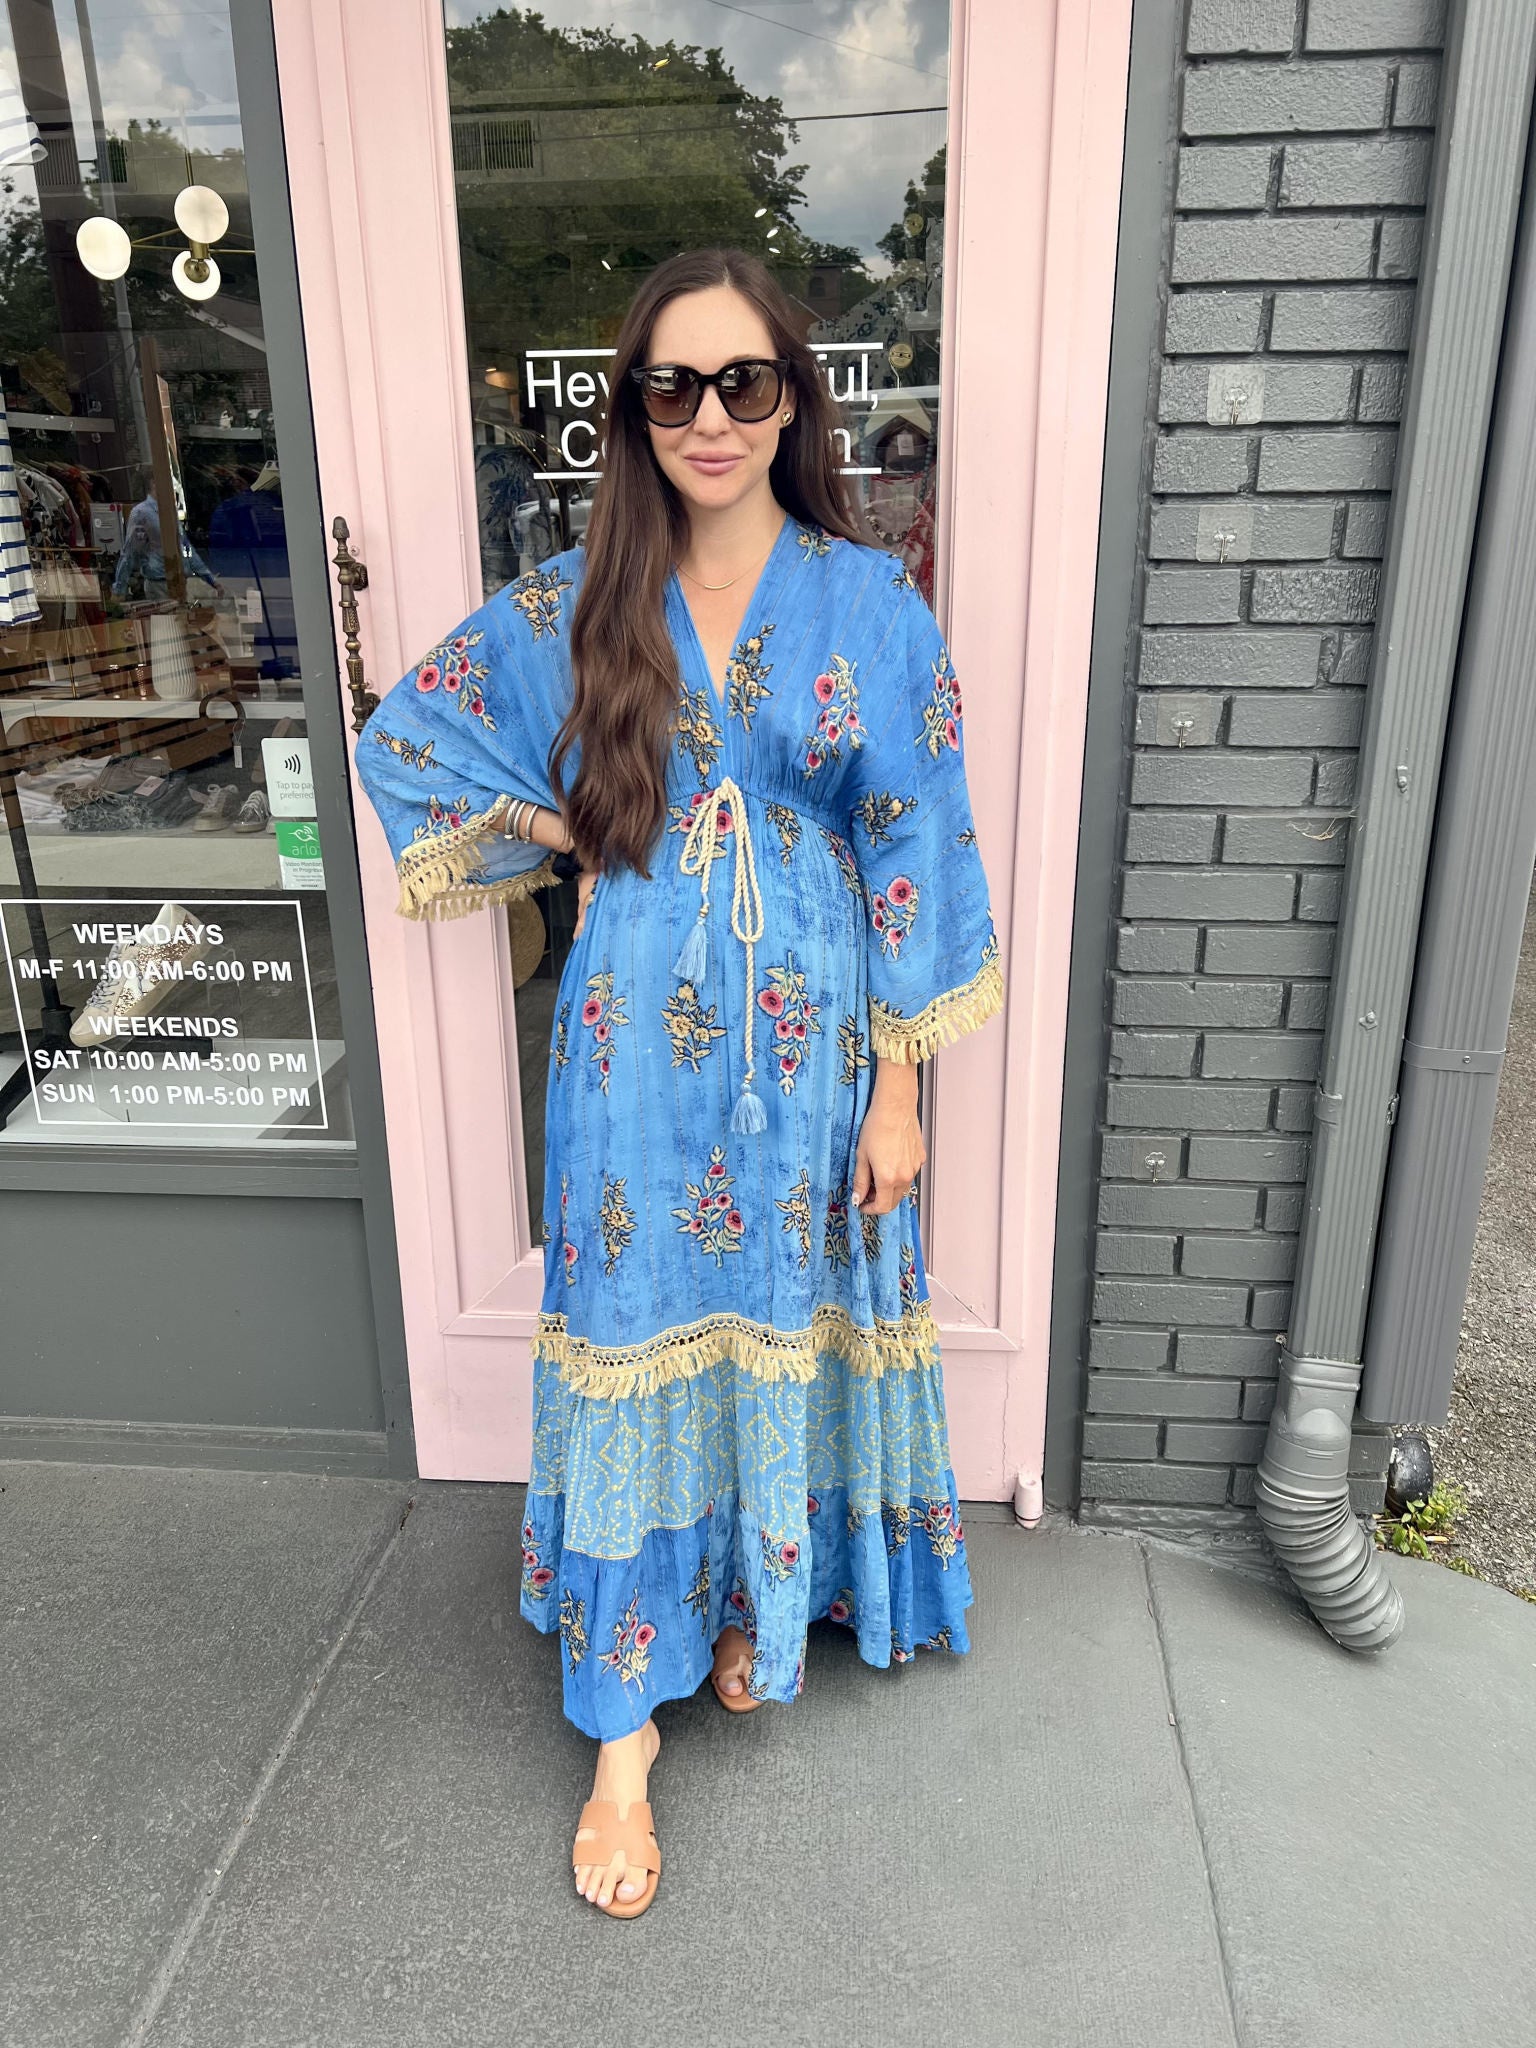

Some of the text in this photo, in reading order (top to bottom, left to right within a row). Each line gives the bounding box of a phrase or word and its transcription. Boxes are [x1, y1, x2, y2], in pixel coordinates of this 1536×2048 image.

[276, 781, 290, 790] Tap
[291, 782, 300, 790] to
[291, 843, 318, 856] arlo
[72, 923, 224, 945] WEEKDAYS
[19, 959, 293, 982] M-F 11:00 AM-6:00 PM
[89, 1016, 239, 1038] WEEKENDS
[34, 1050, 307, 1073] SAT 10:00 AM-5:00 PM
[43, 1084, 311, 1107] SUN 1:00 PM-5:00 PM
